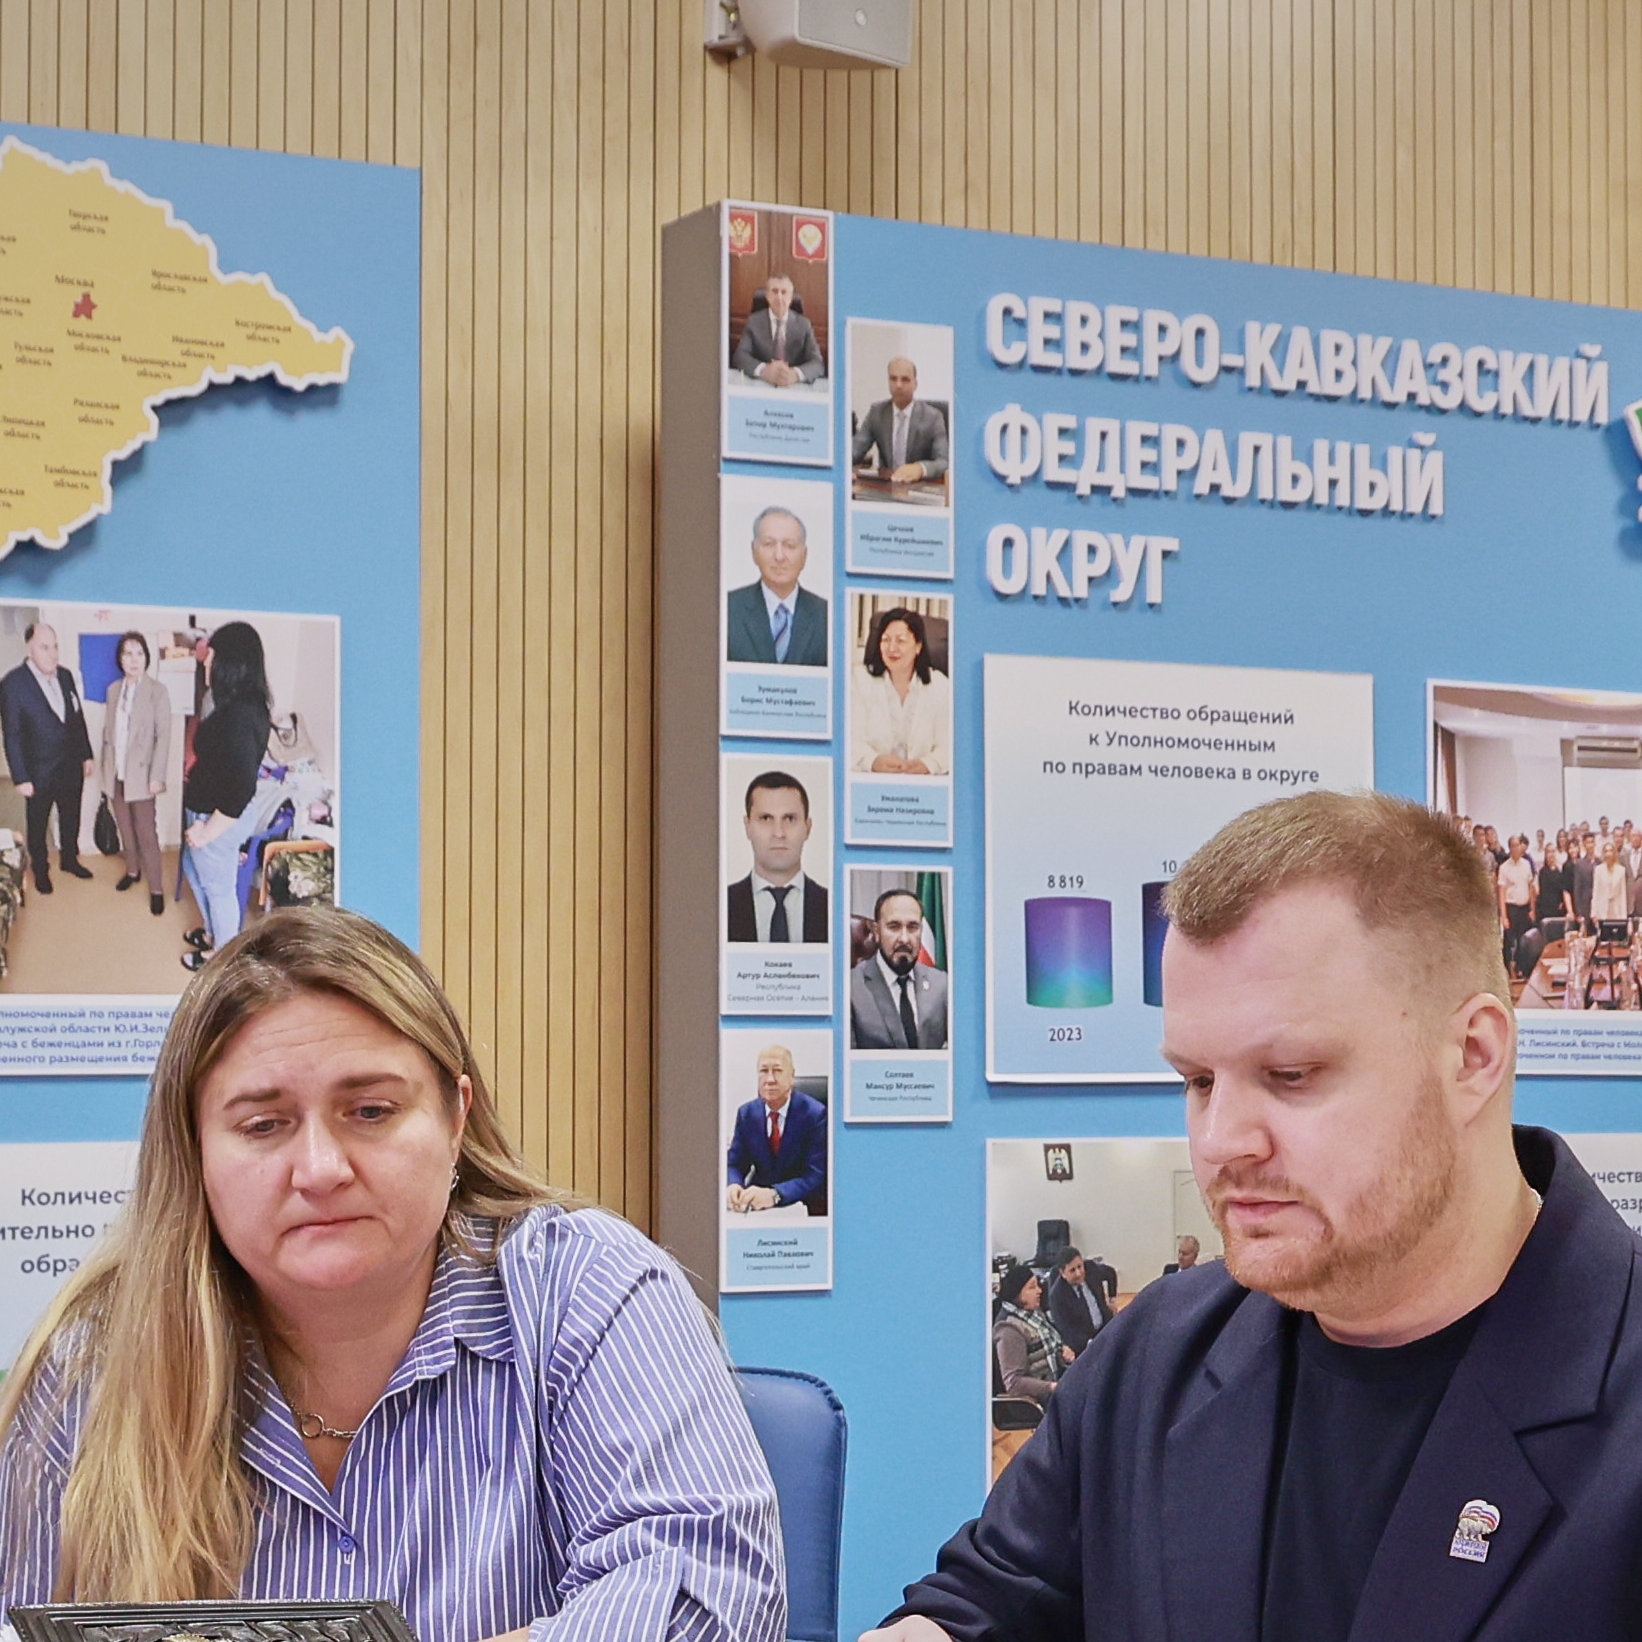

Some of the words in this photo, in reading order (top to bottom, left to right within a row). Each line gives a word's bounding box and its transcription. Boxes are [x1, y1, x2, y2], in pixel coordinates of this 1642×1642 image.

[986, 292, 1609, 426] СЕВЕРО-КАВКАЗСКИЙ
[984, 403, 1444, 517] ФЕДЕРАЛЬНЫЙ
[986, 523, 1179, 605] ОКРУГ
[1068, 700, 1181, 721] Количество
[1186, 704, 1295, 726] обращений
[1089, 732, 1100, 747] к
[1106, 731, 1276, 754] Уполномоченным
[1042, 761, 1066, 775] по
[1072, 761, 1143, 780] правам
[1148, 764, 1236, 781] человека
[1242, 768, 1252, 781] в
[1257, 768, 1320, 786] округе
[1047, 875, 1056, 889] 8
[1059, 874, 1084, 889] 819
[89, 1011, 105, 1020] по
[108, 1011, 153, 1022] правам
[60, 1024, 111, 1034] области
[1048, 1027, 1083, 1042] 2023
[31, 1039, 104, 1050] беженцами
[108, 1041, 122, 1049] из
[49, 1054, 128, 1066] размещения
